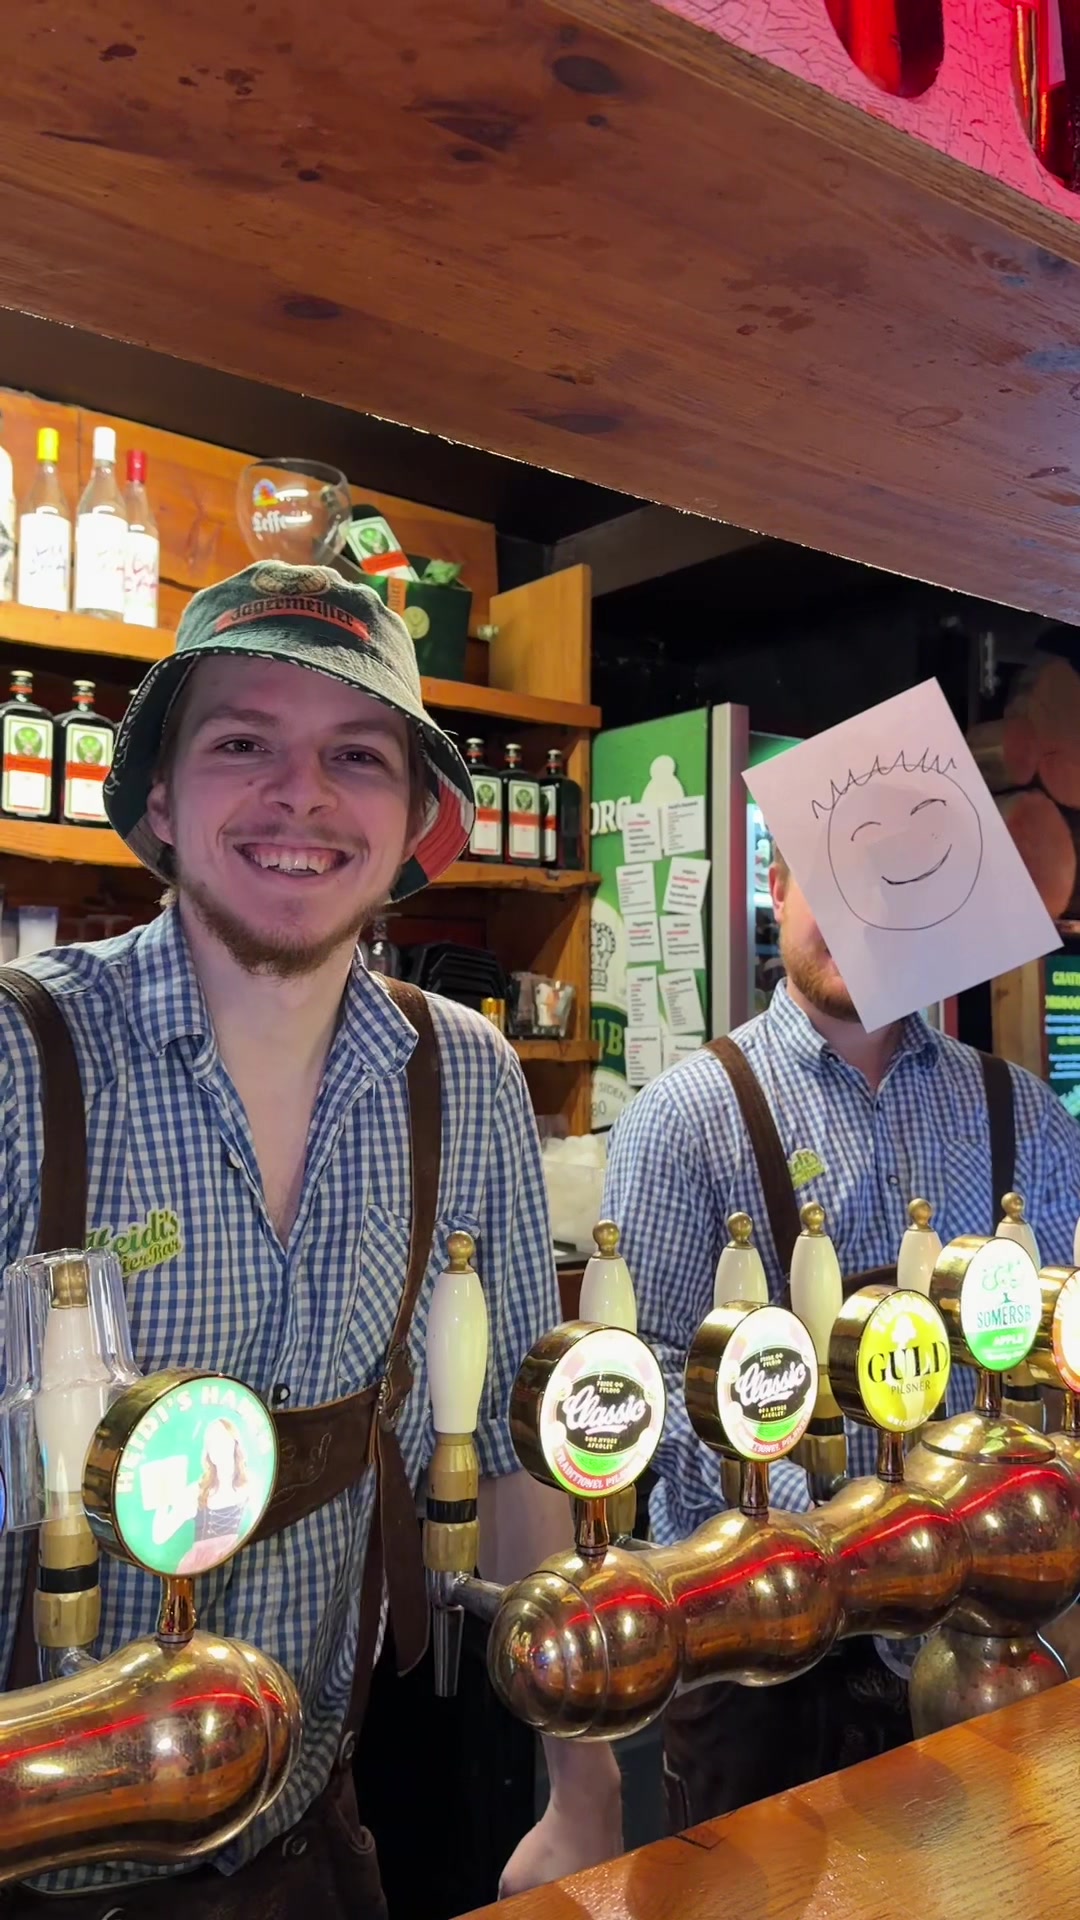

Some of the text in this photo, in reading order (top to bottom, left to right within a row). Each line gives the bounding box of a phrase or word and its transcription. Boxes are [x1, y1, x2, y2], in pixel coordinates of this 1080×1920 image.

[735, 1360, 806, 1406] Classic
[867, 1341, 949, 1383] GULD
[562, 1385, 646, 1430] Classic
[891, 1380, 931, 1395] PILSNER
